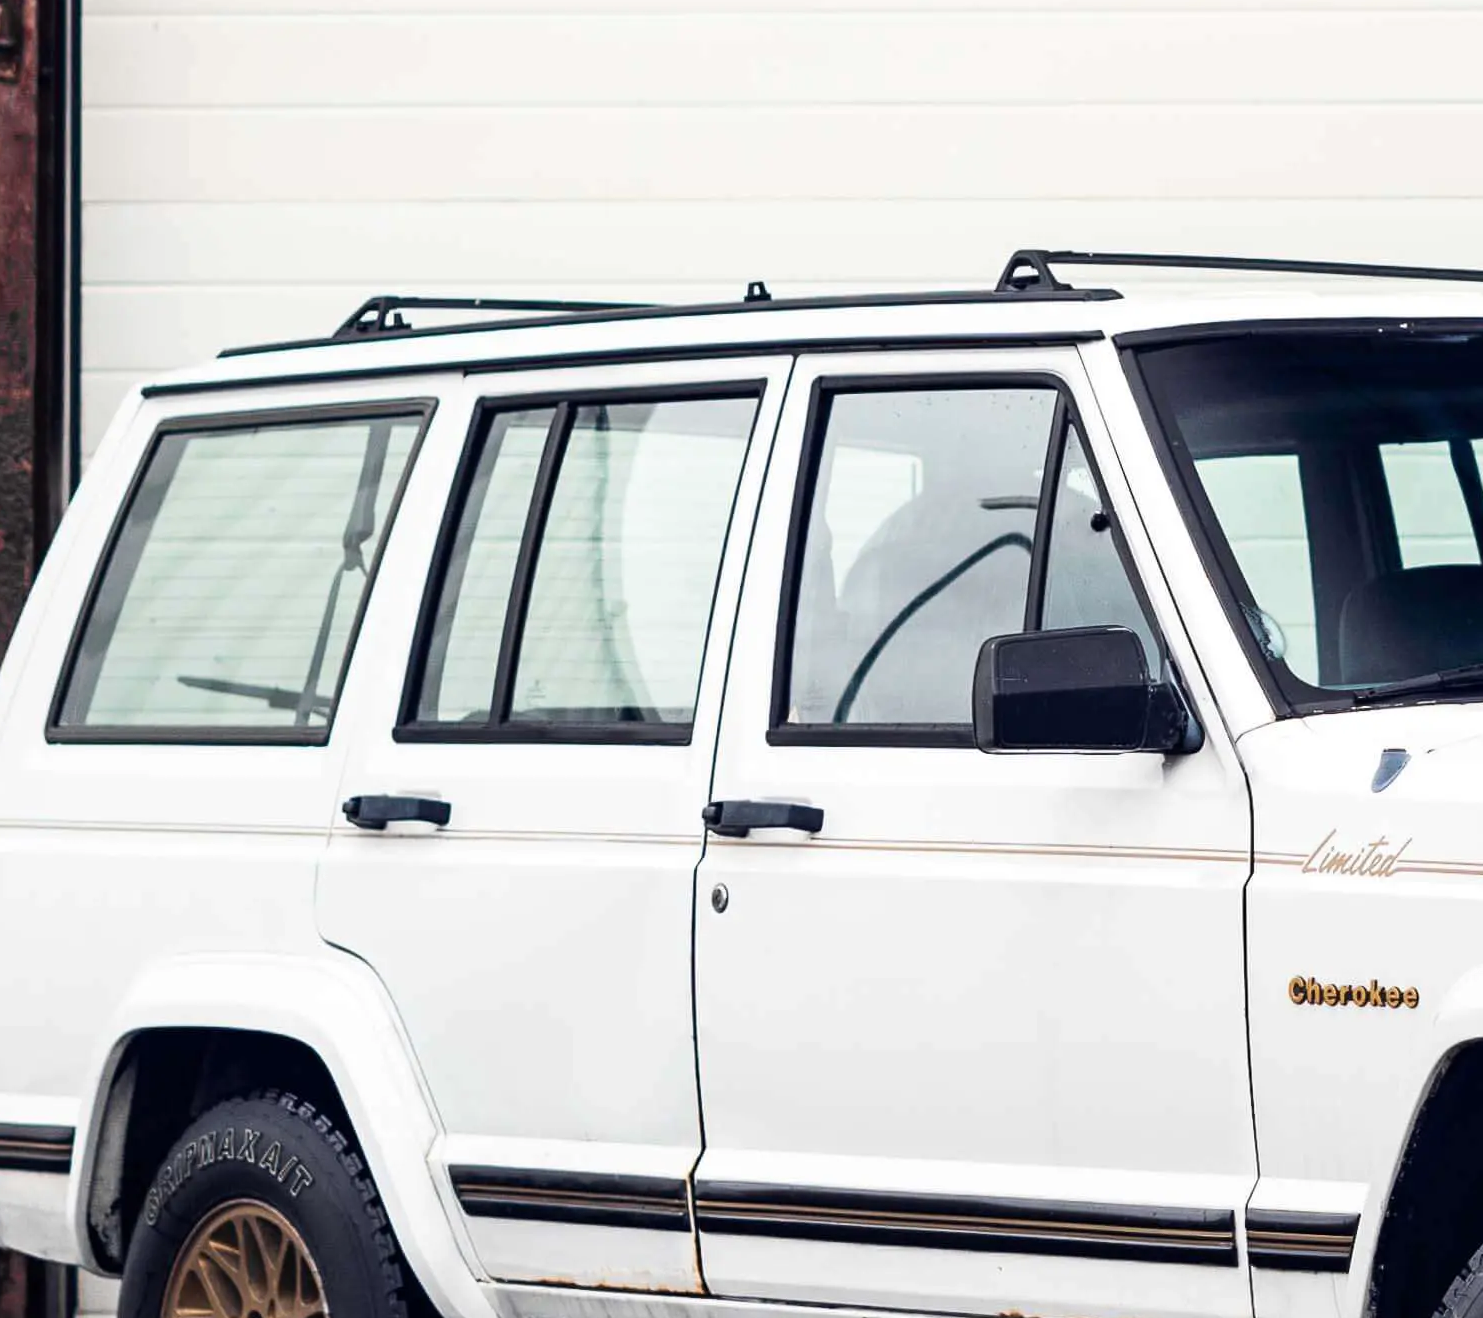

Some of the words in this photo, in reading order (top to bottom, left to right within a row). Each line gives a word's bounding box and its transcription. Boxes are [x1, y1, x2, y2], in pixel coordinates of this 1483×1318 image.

[1302, 828, 1412, 877] Limited
[1288, 975, 1419, 1008] Cherokee
[144, 1127, 260, 1226] GRIPMAX
